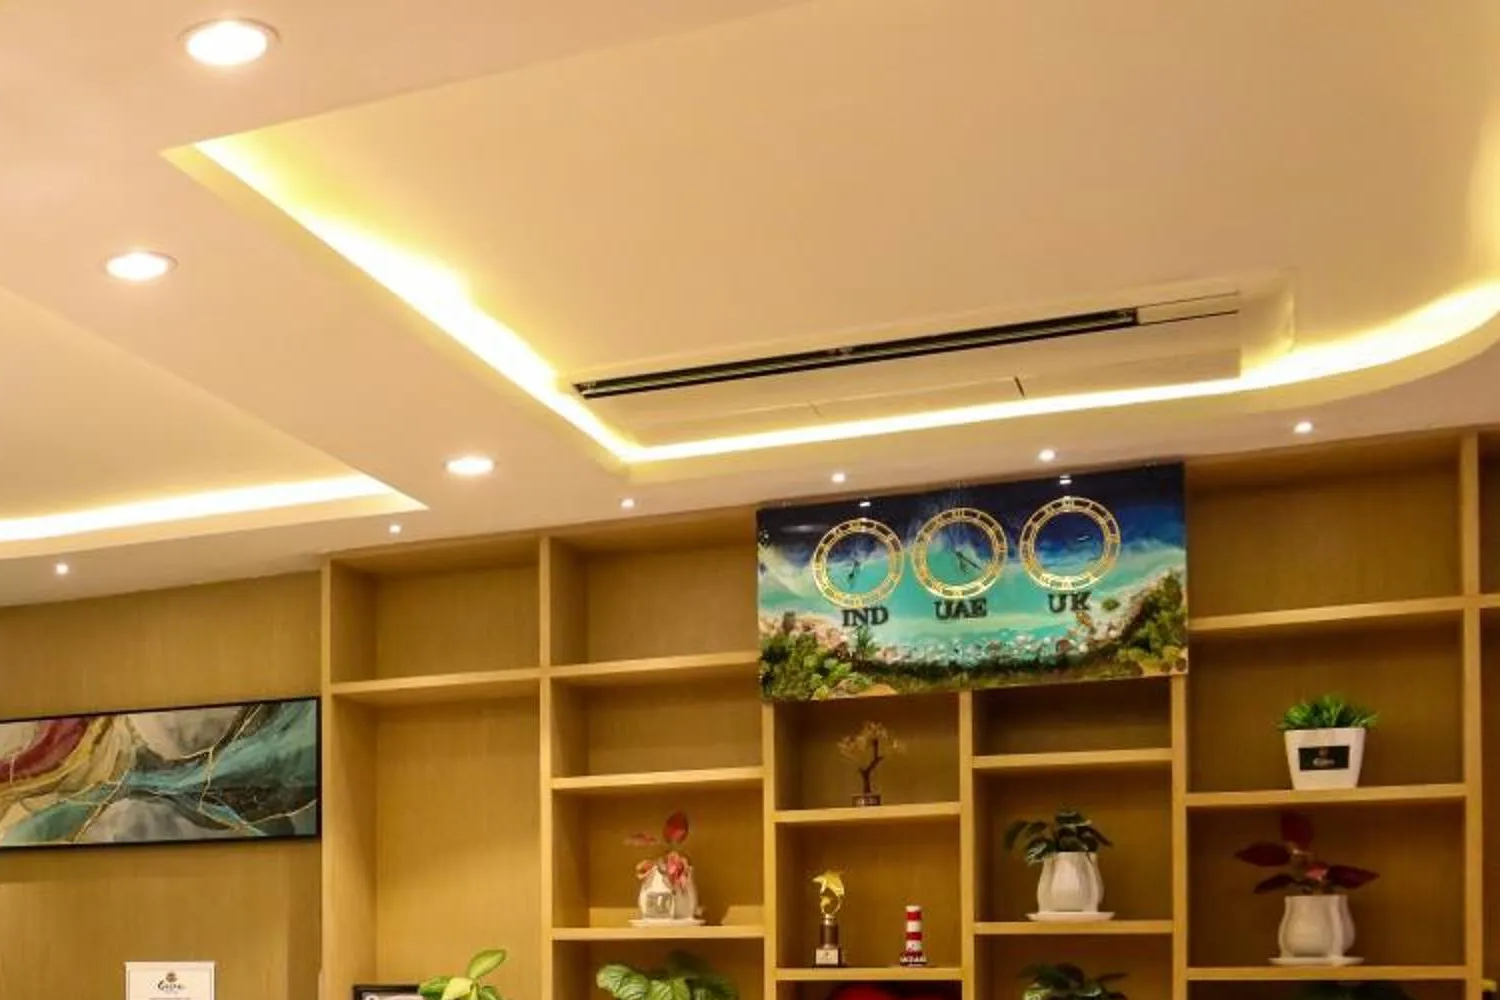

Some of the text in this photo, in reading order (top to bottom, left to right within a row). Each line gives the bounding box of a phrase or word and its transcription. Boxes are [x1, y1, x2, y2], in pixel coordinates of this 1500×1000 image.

[933, 597, 988, 620] UAE
[1048, 592, 1092, 613] UK
[841, 605, 889, 627] IND
